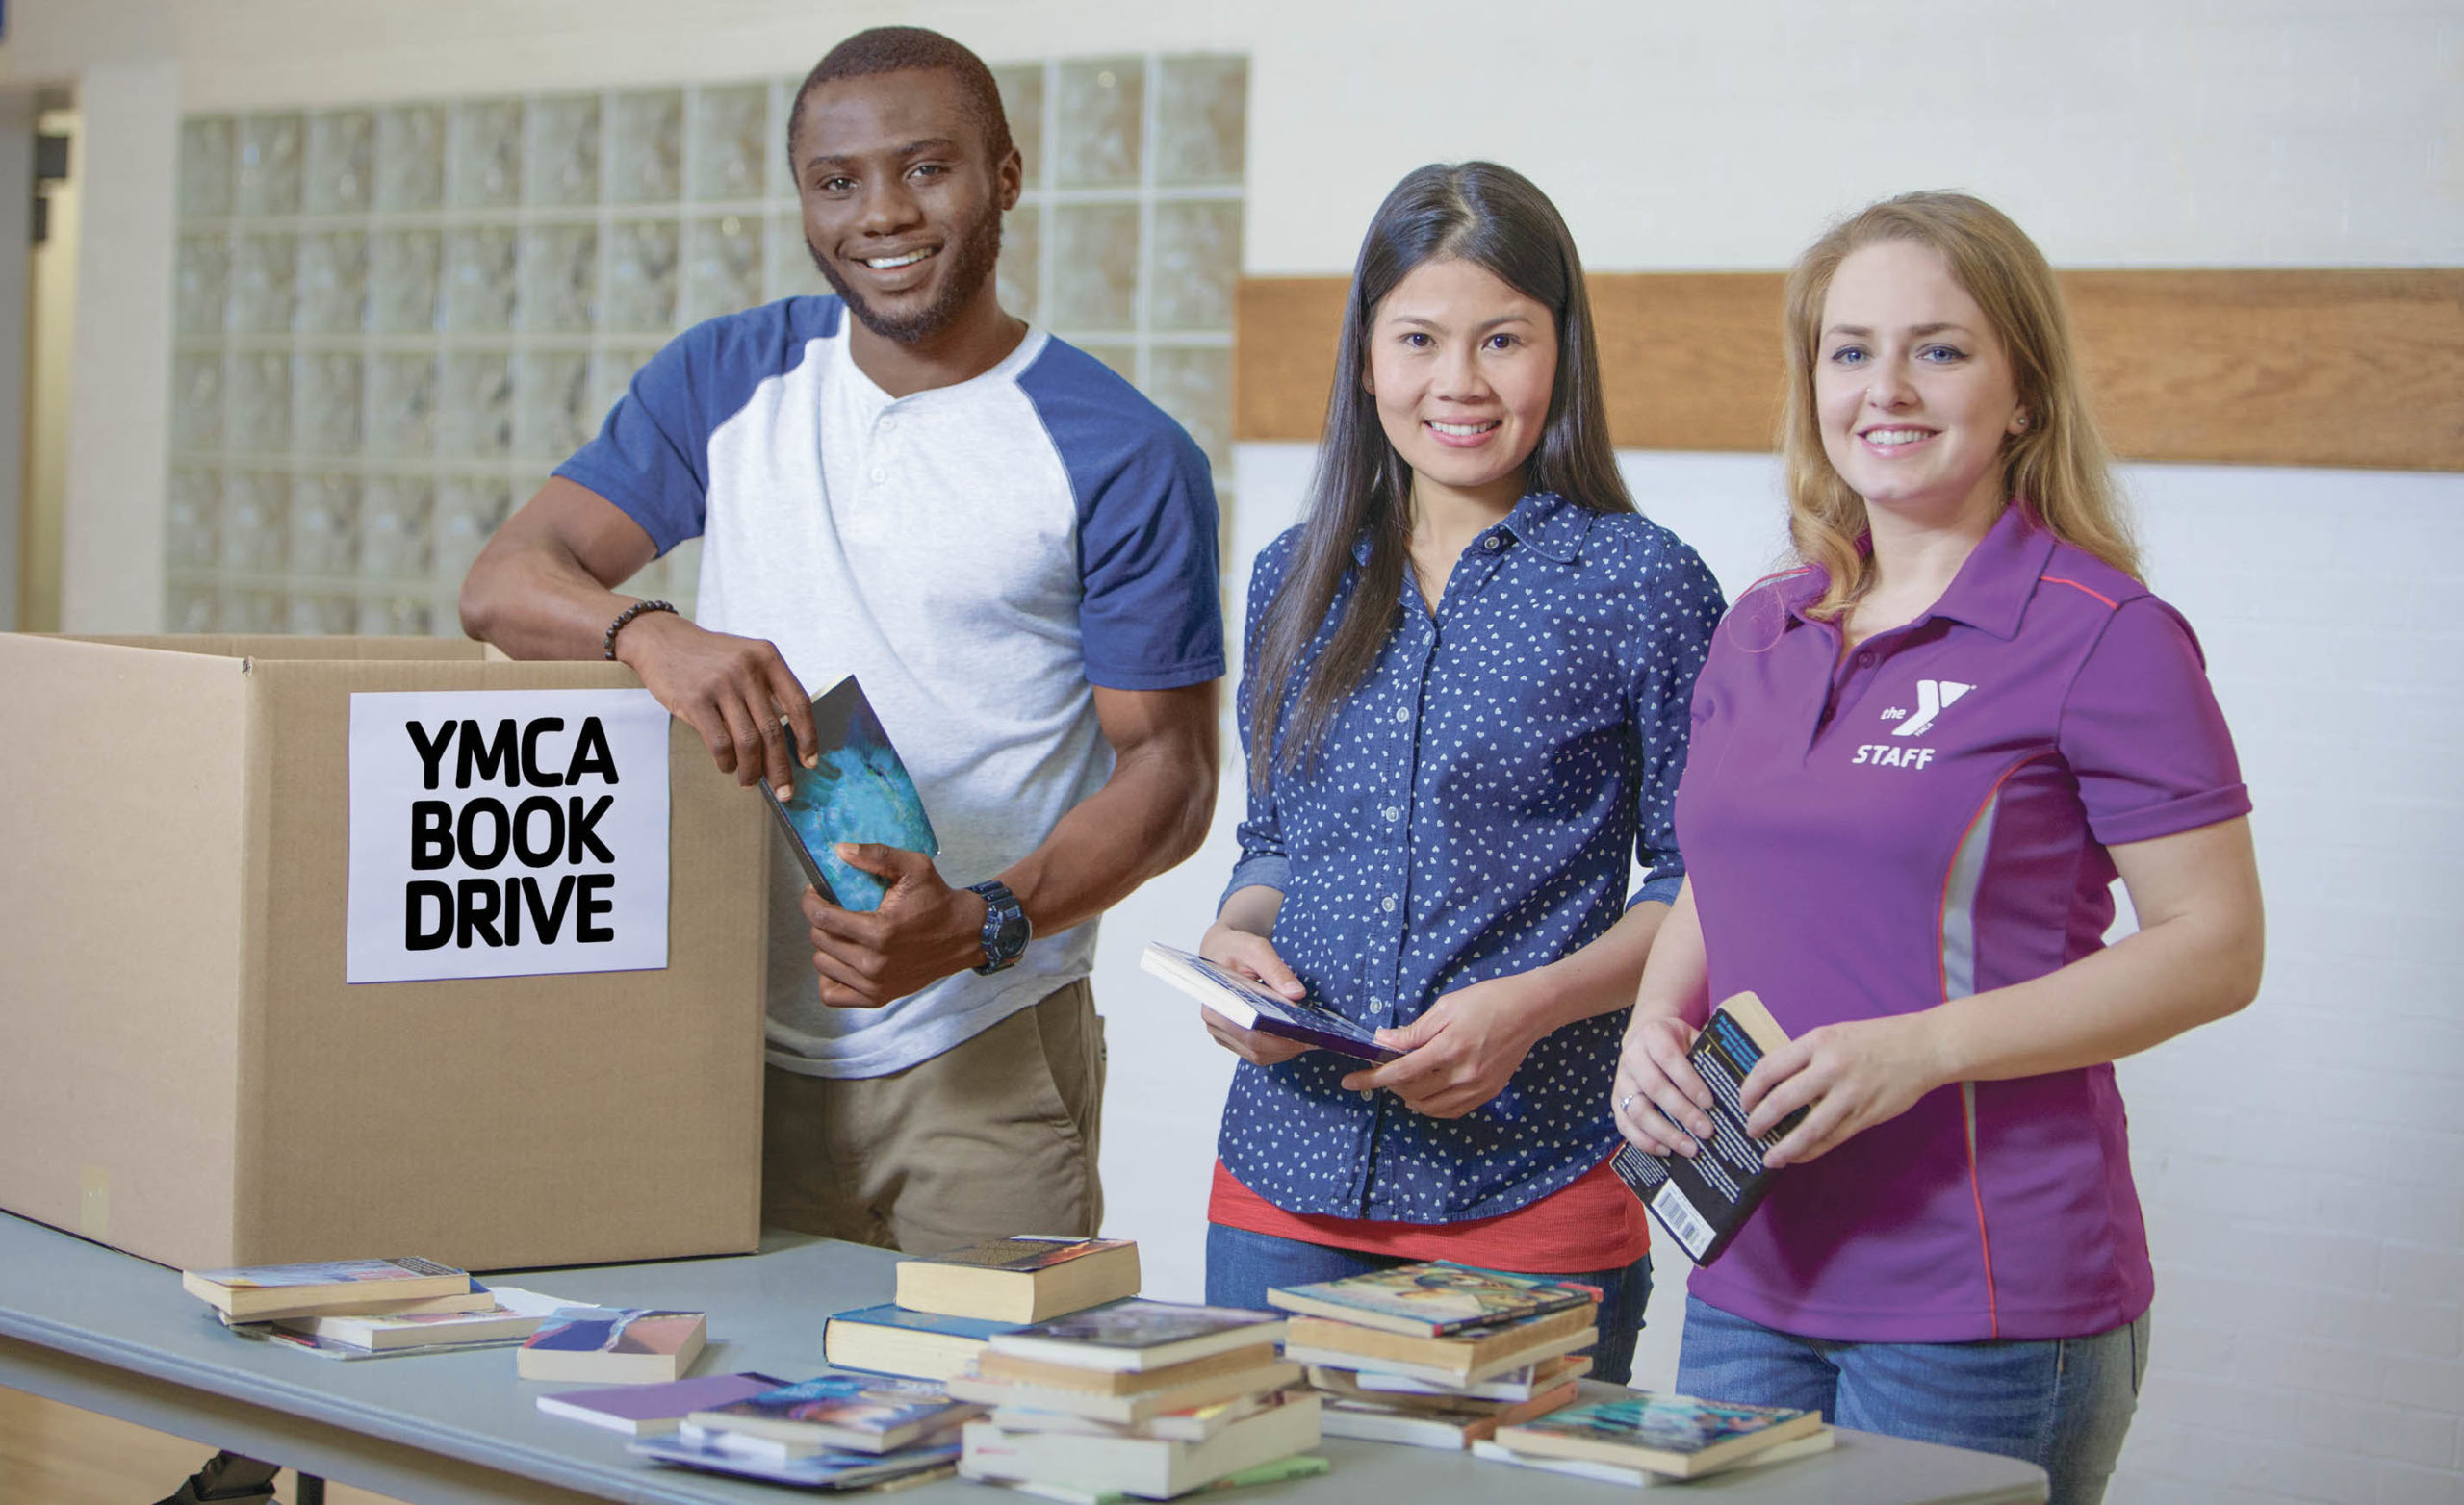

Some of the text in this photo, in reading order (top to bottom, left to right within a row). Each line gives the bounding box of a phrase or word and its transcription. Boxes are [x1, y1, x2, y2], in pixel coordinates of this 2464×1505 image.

[1880, 706, 1908, 720] the
[405, 716, 620, 789] YMCA
[1852, 745, 1935, 769] STAFF
[411, 795, 615, 870] BOOK
[405, 873, 615, 951] DRIVE
